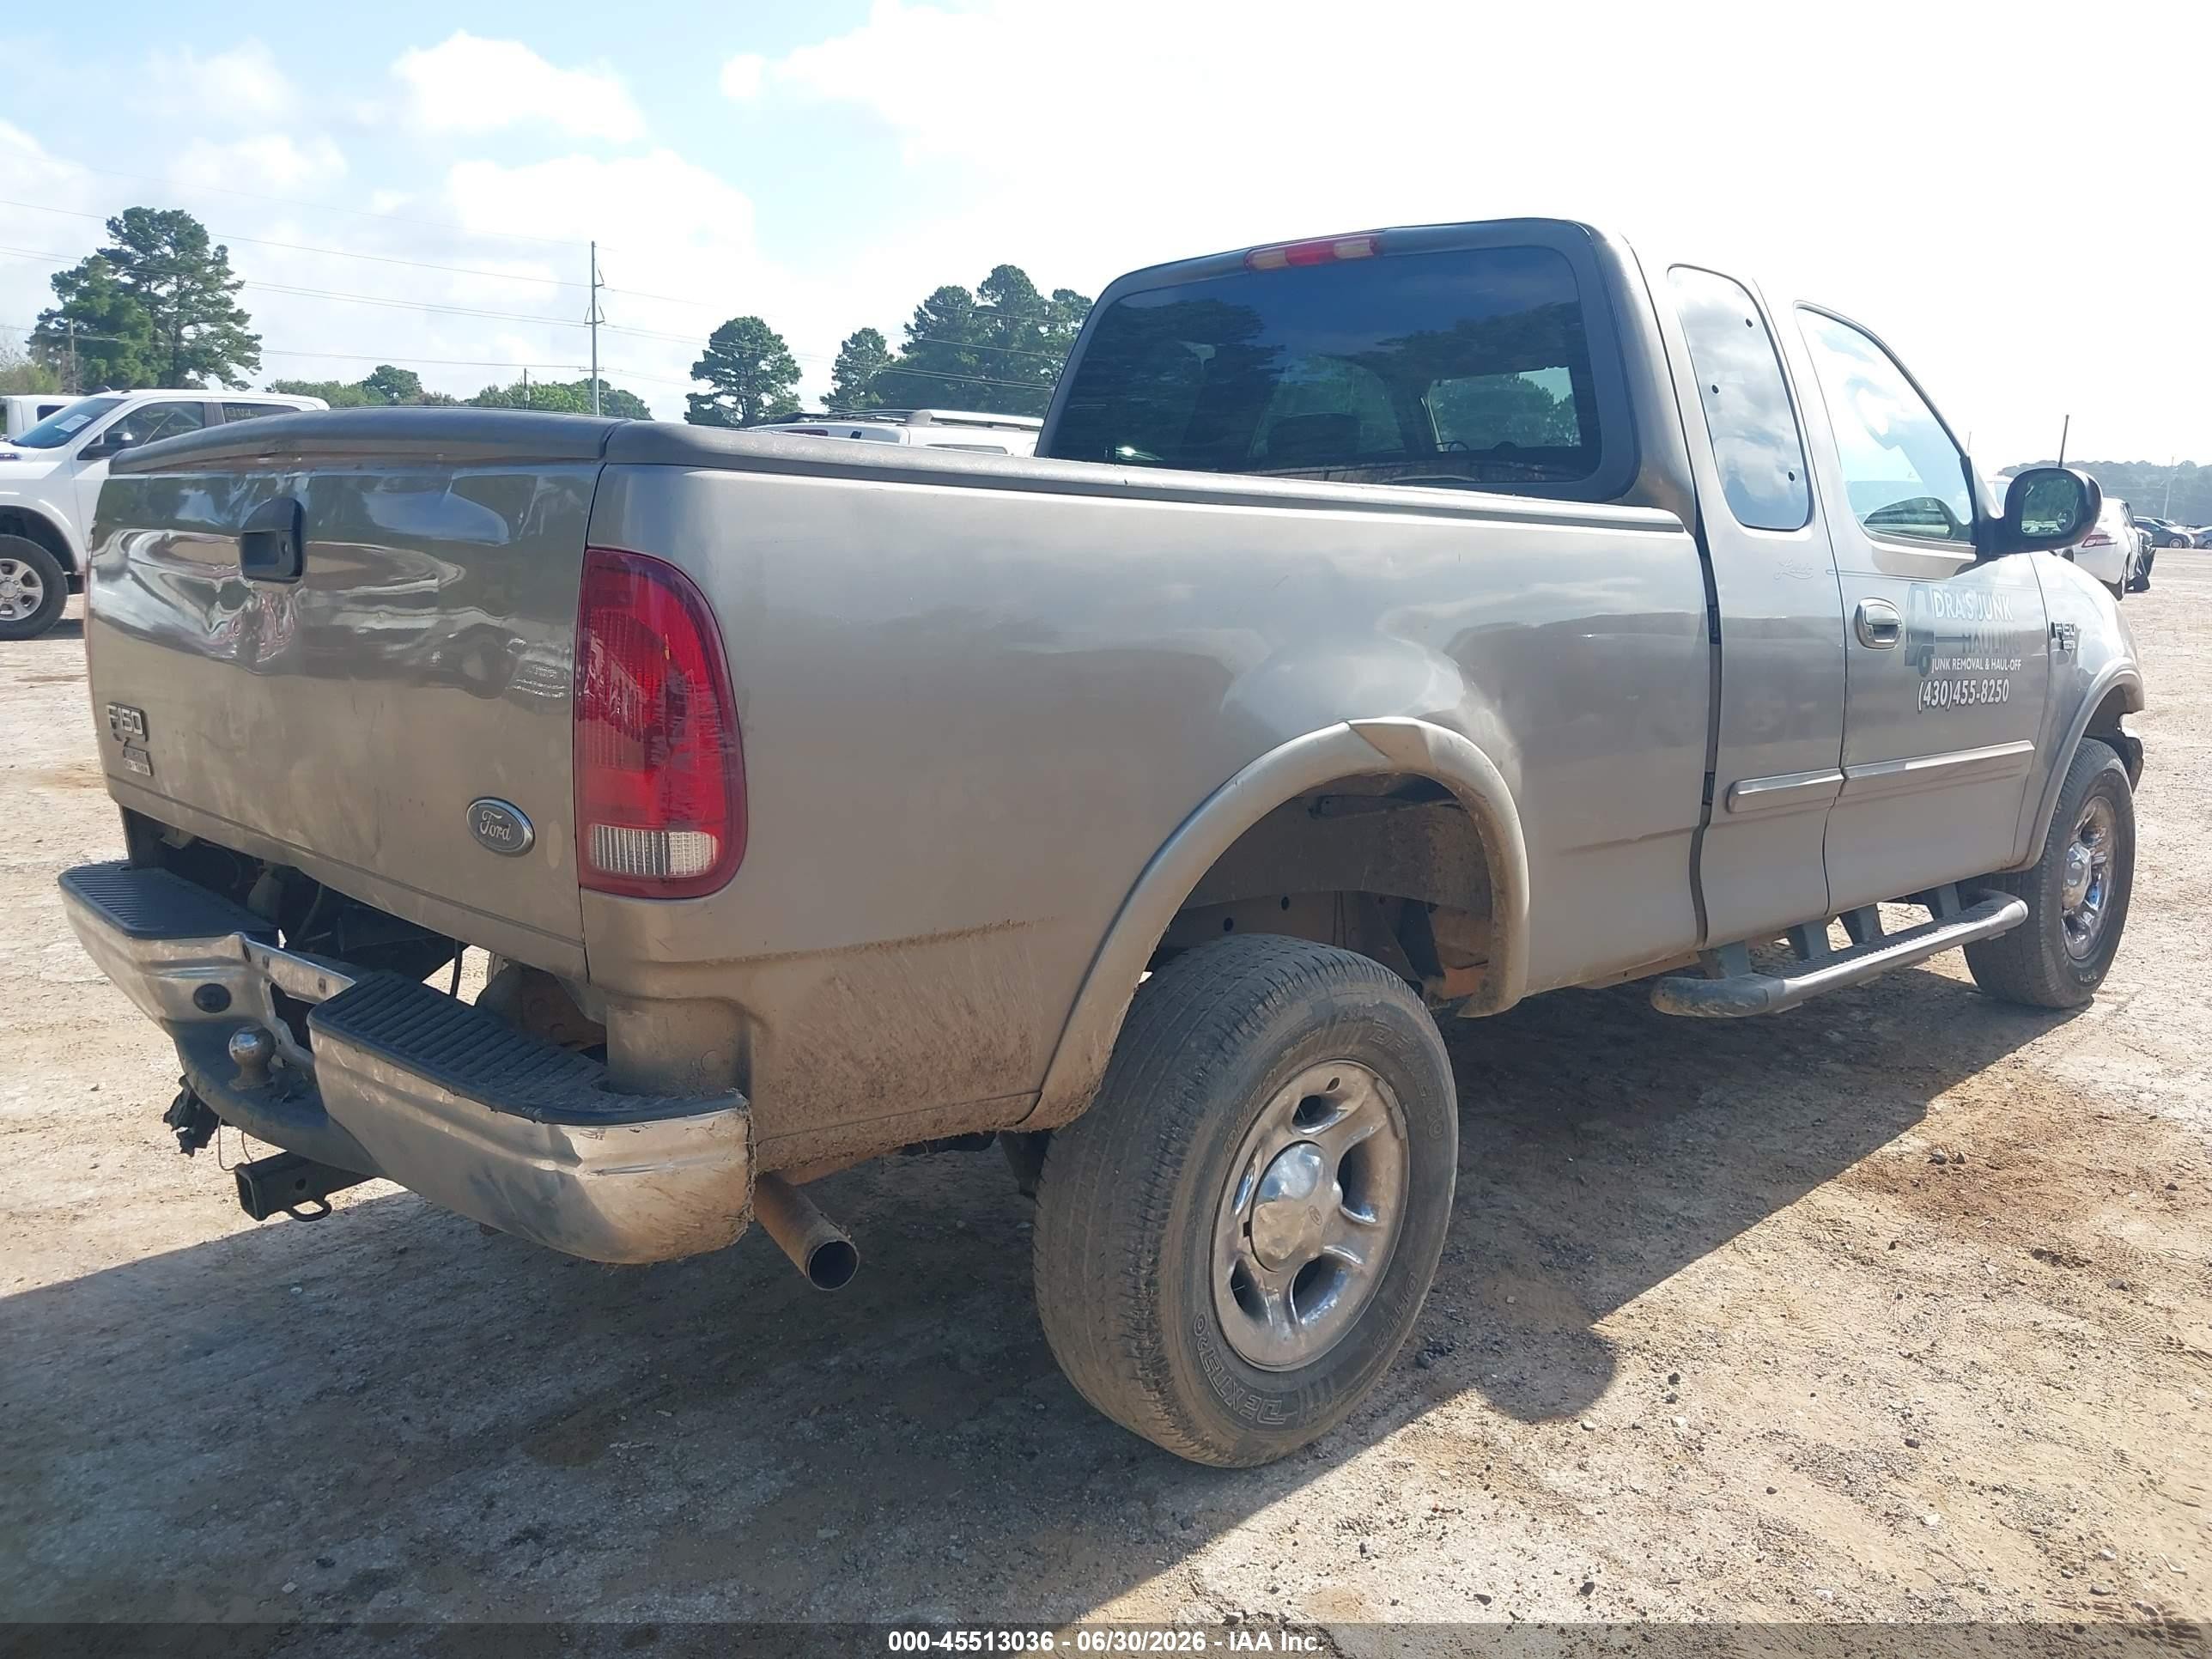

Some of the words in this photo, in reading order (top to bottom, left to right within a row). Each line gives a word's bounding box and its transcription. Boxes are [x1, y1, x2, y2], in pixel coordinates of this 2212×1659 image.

[1978, 592, 2014, 622] JUNK
[1931, 658, 1951, 674] JUNK
[1952, 658, 1984, 671] REMOVAL
[1984, 658, 1990, 671] &
[1990, 658, 2022, 672] HAUL-OFF
[1917, 678, 2010, 712] (430)455-8250
[479, 810, 512, 842] Ford
[1194, 1311, 1298, 1425] DEXTERO
